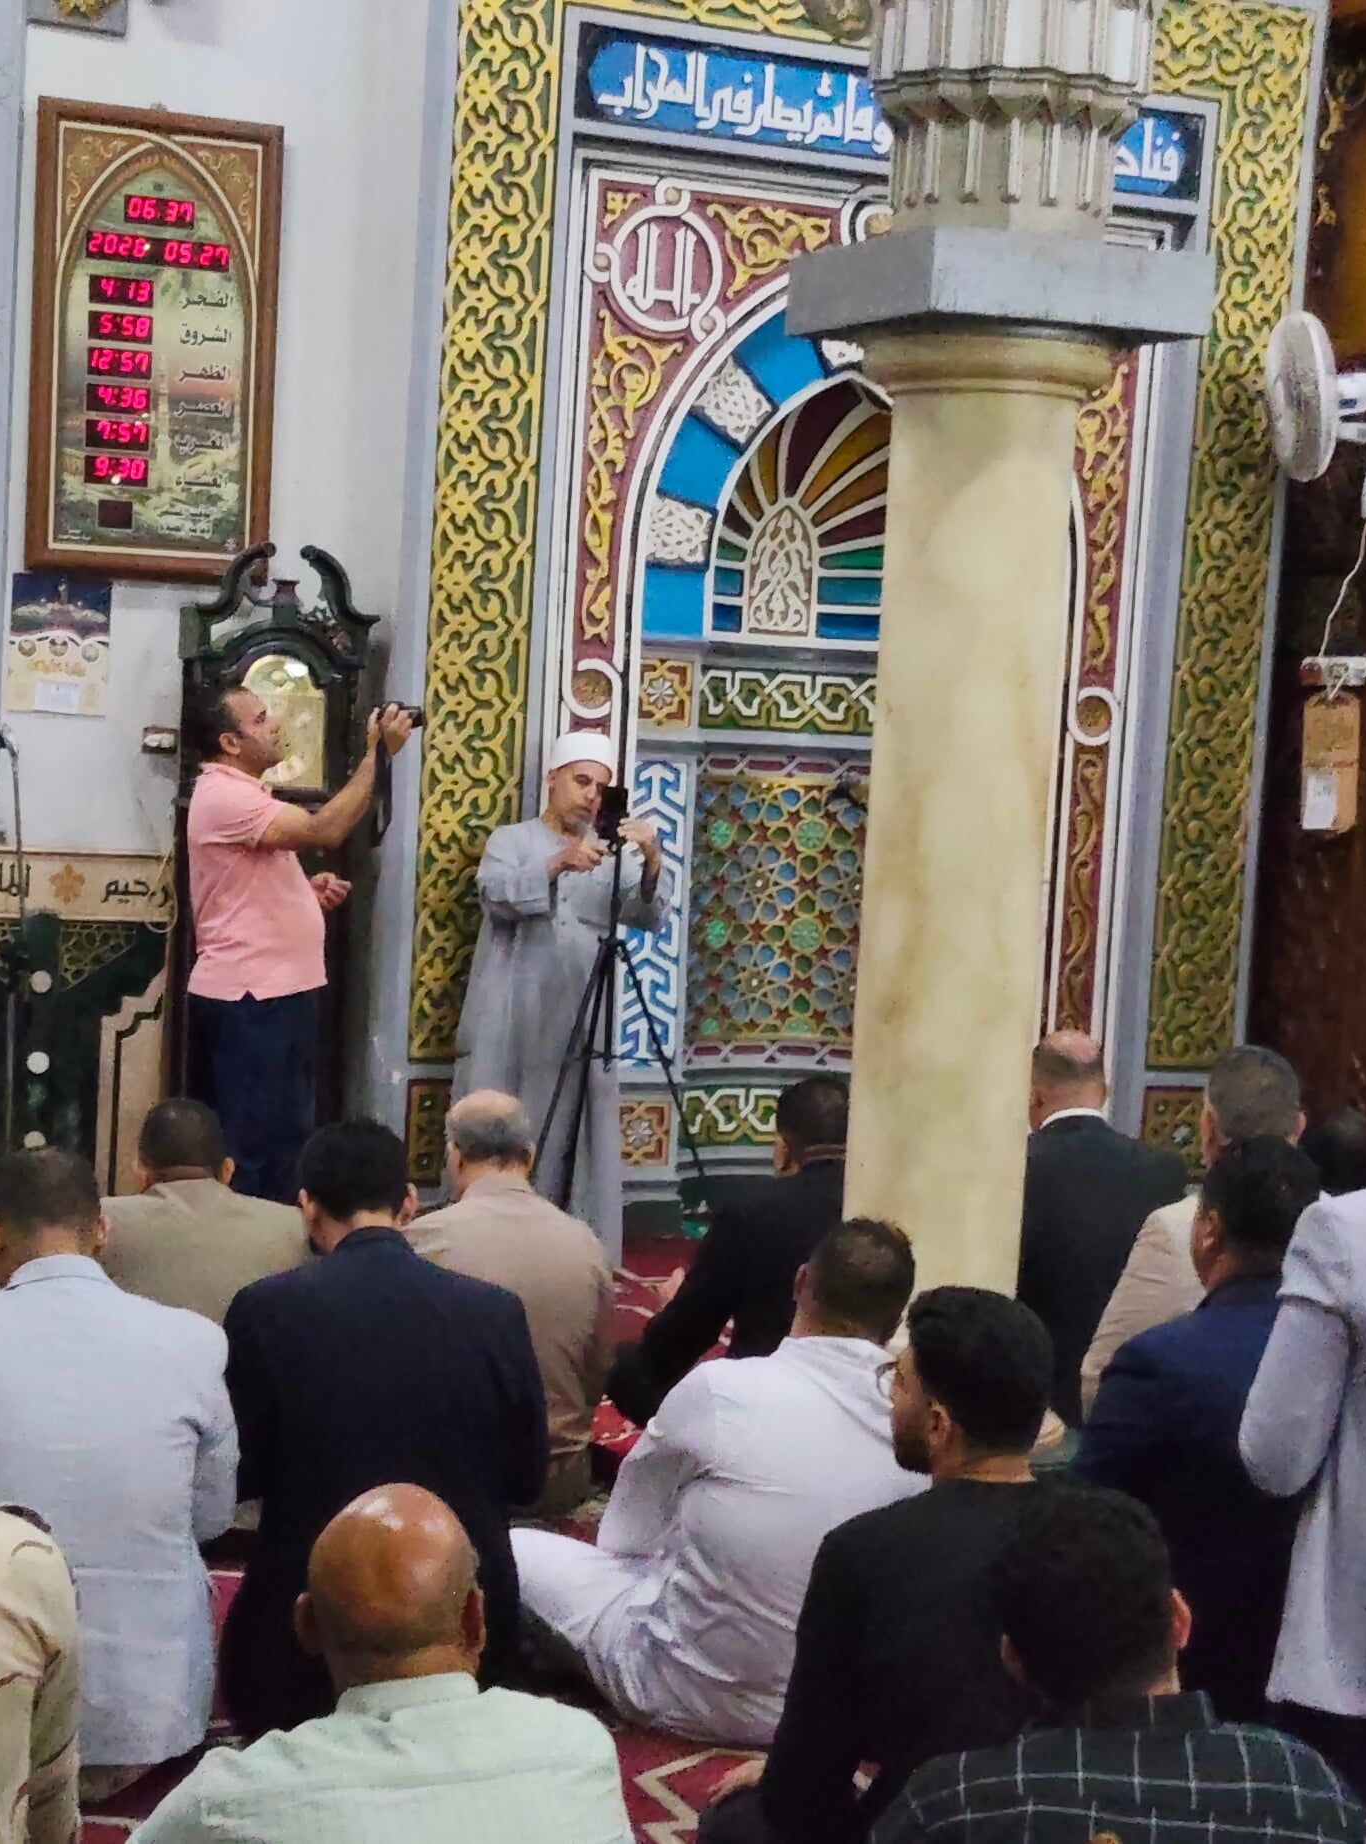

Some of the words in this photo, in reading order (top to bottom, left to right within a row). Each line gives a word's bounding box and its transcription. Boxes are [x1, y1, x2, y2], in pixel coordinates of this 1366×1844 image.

[624, 221, 702, 316] الله
[179, 291, 233, 312] الفجر
[99, 312, 150, 338] 5:58
[179, 324, 232, 346] الشروق
[90, 349, 150, 373] 12:57
[178, 364, 231, 382] الظهر
[101, 879, 169, 908] رحيم
